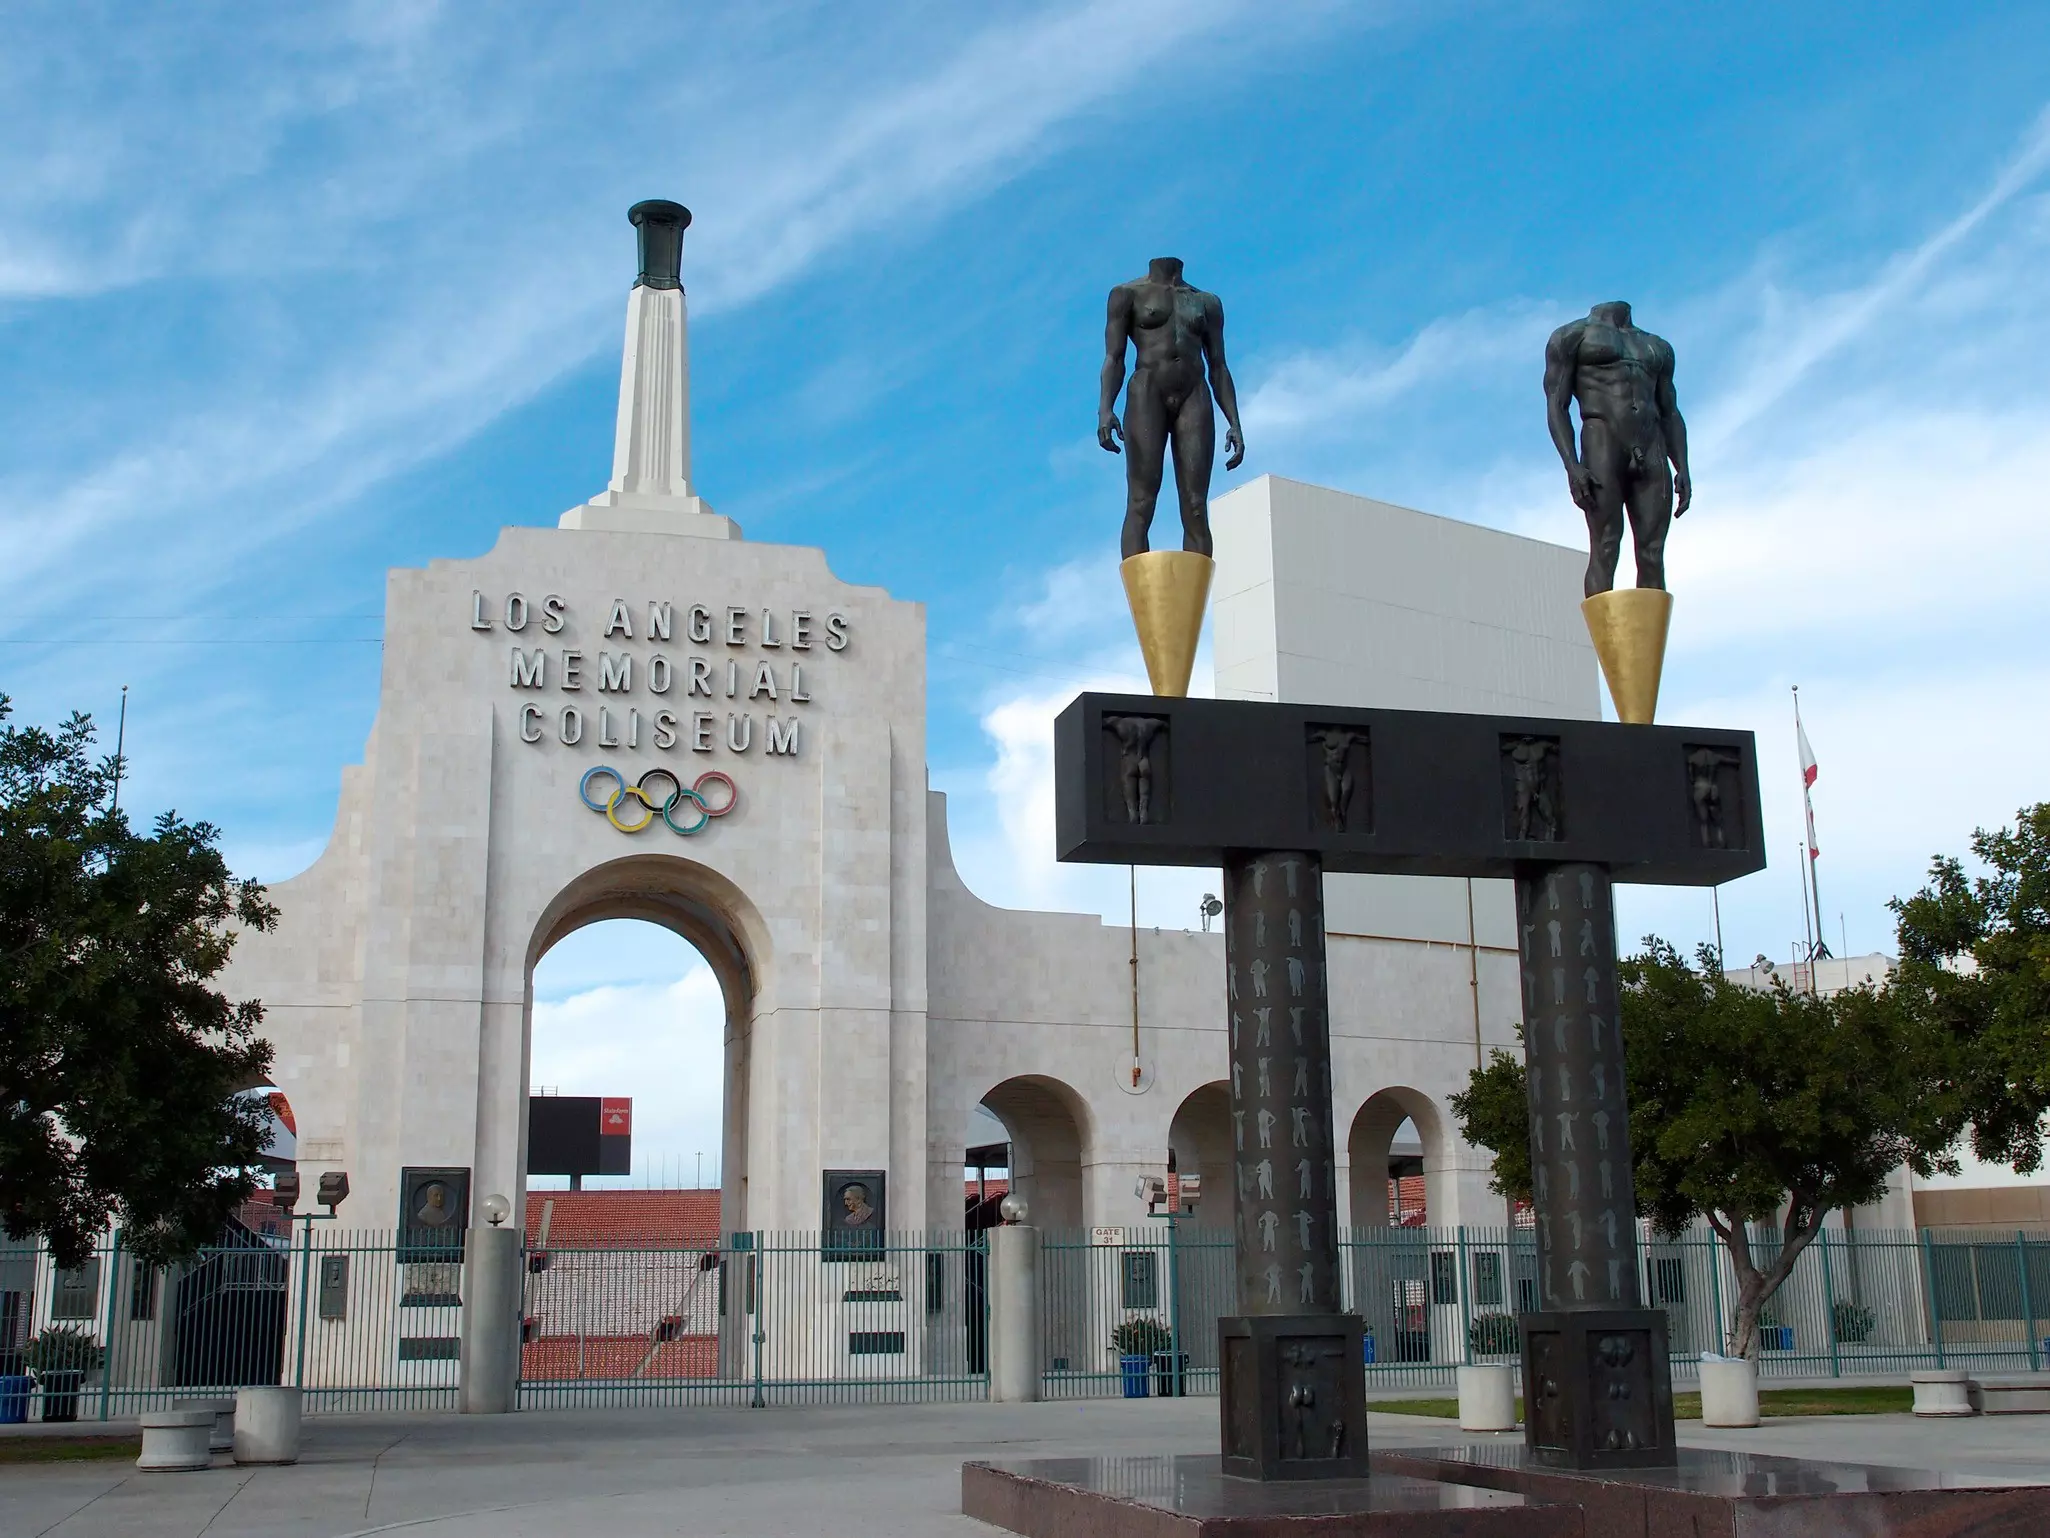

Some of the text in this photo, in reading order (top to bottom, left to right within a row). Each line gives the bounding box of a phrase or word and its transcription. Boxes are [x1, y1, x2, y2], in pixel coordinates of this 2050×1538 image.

[471, 590, 849, 652] LOS ANGELES
[509, 647, 811, 703] MEMORIAL
[519, 702, 798, 756] COLISEUM
[1096, 1228, 1120, 1236] GATE
[1103, 1236, 1113, 1244] 31
